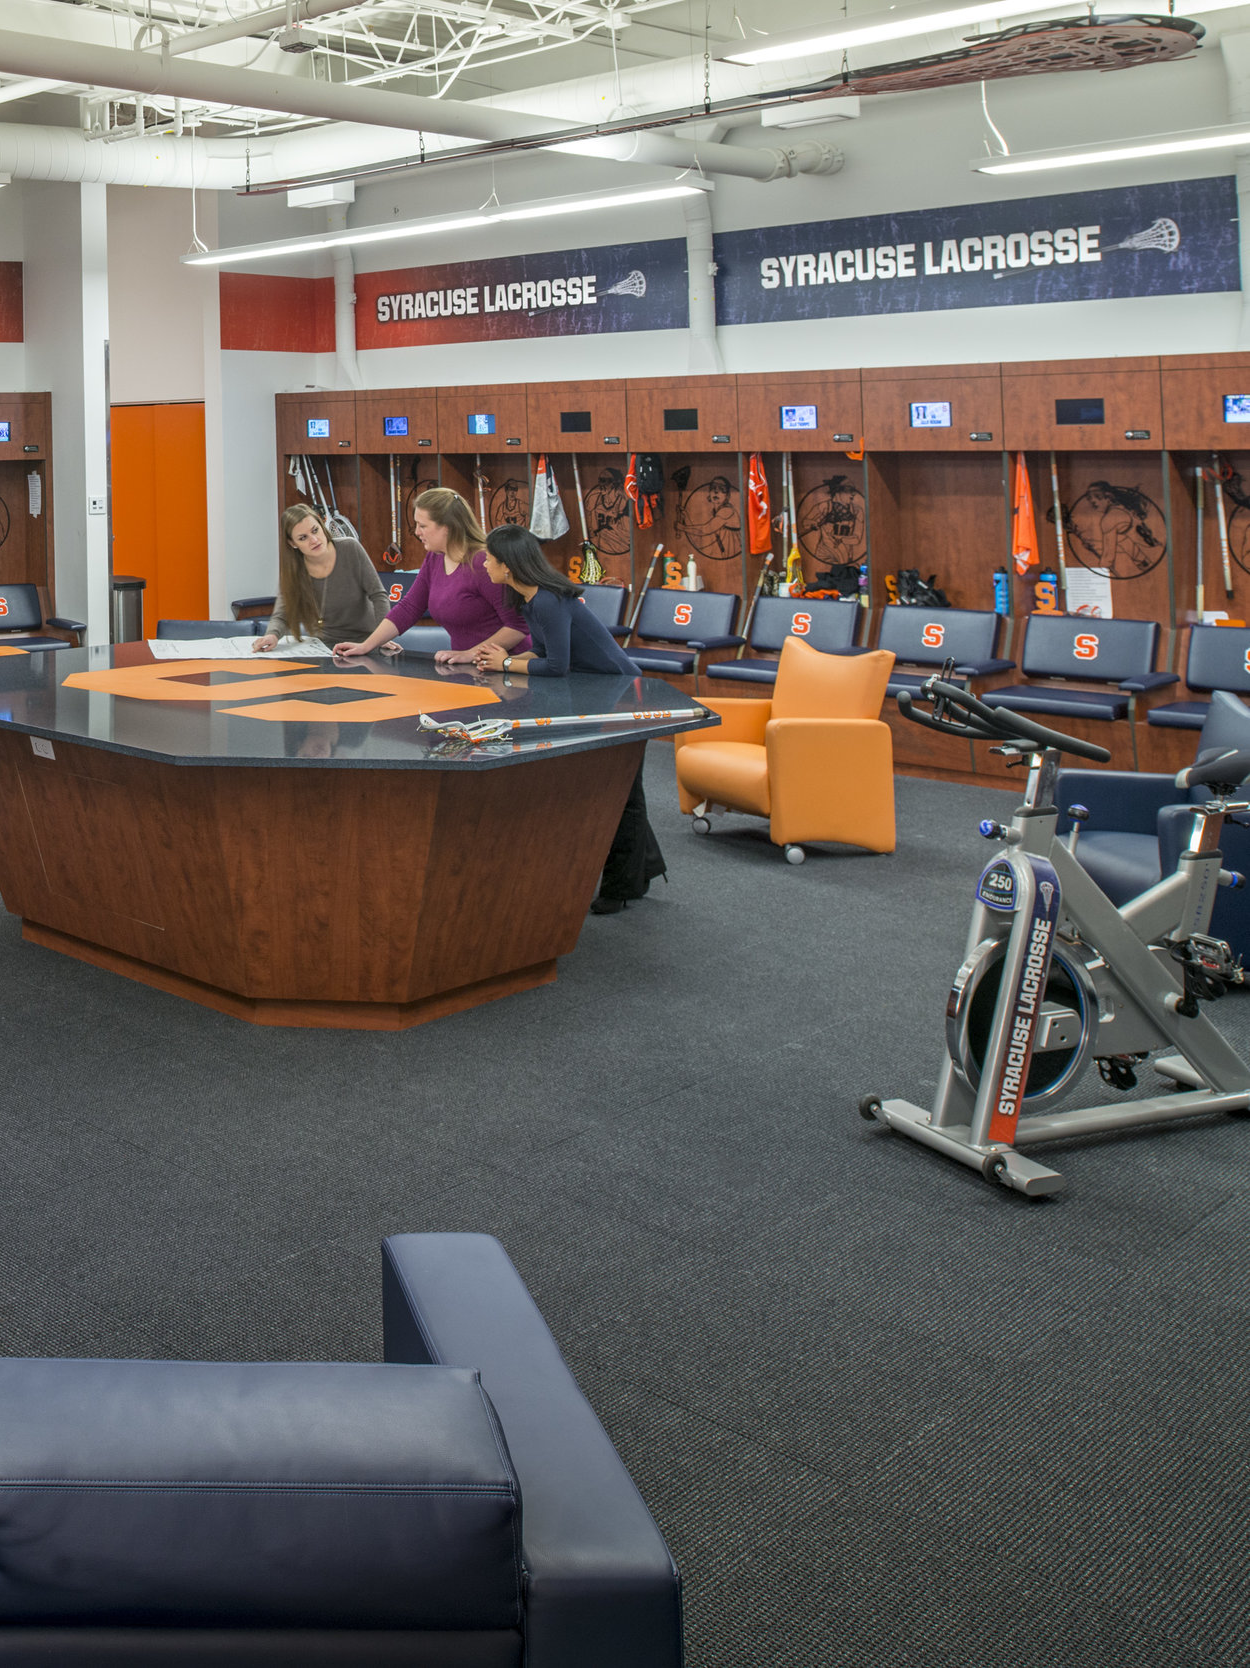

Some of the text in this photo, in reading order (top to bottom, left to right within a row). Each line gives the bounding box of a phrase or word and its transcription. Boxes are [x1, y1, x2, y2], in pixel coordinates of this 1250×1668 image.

[760, 225, 1102, 289] SYRACUSE LACROSSE
[377, 275, 597, 322] SYRACUSE LACROSSE
[389, 583, 403, 602] S
[674, 603, 692, 625] S
[791, 612, 812, 635] S
[922, 623, 945, 648] S
[1073, 633, 1099, 660] S
[989, 873, 1013, 891] 250
[981, 890, 1013, 904] ENDURANCE
[999, 918, 1052, 1116] SYRACUSE LACROSSE
